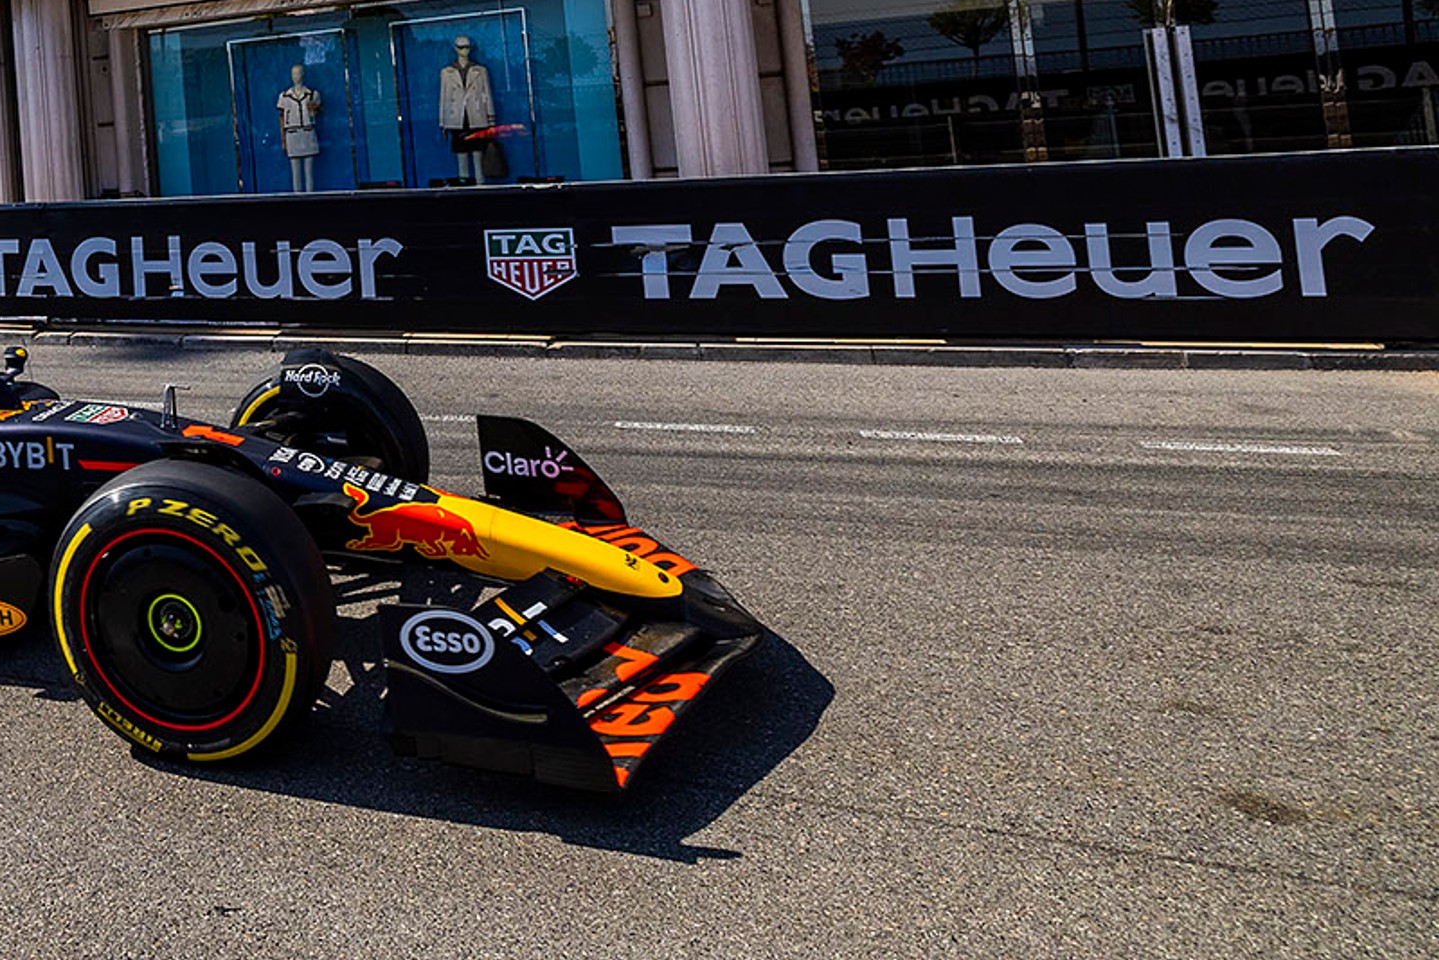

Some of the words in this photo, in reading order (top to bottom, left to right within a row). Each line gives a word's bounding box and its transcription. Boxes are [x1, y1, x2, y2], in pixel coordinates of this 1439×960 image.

[491, 234, 566, 255] TAG
[284, 369, 314, 382] Hard
[484, 448, 561, 479] Claro
[126, 497, 152, 516] P
[157, 499, 268, 572] ZERO
